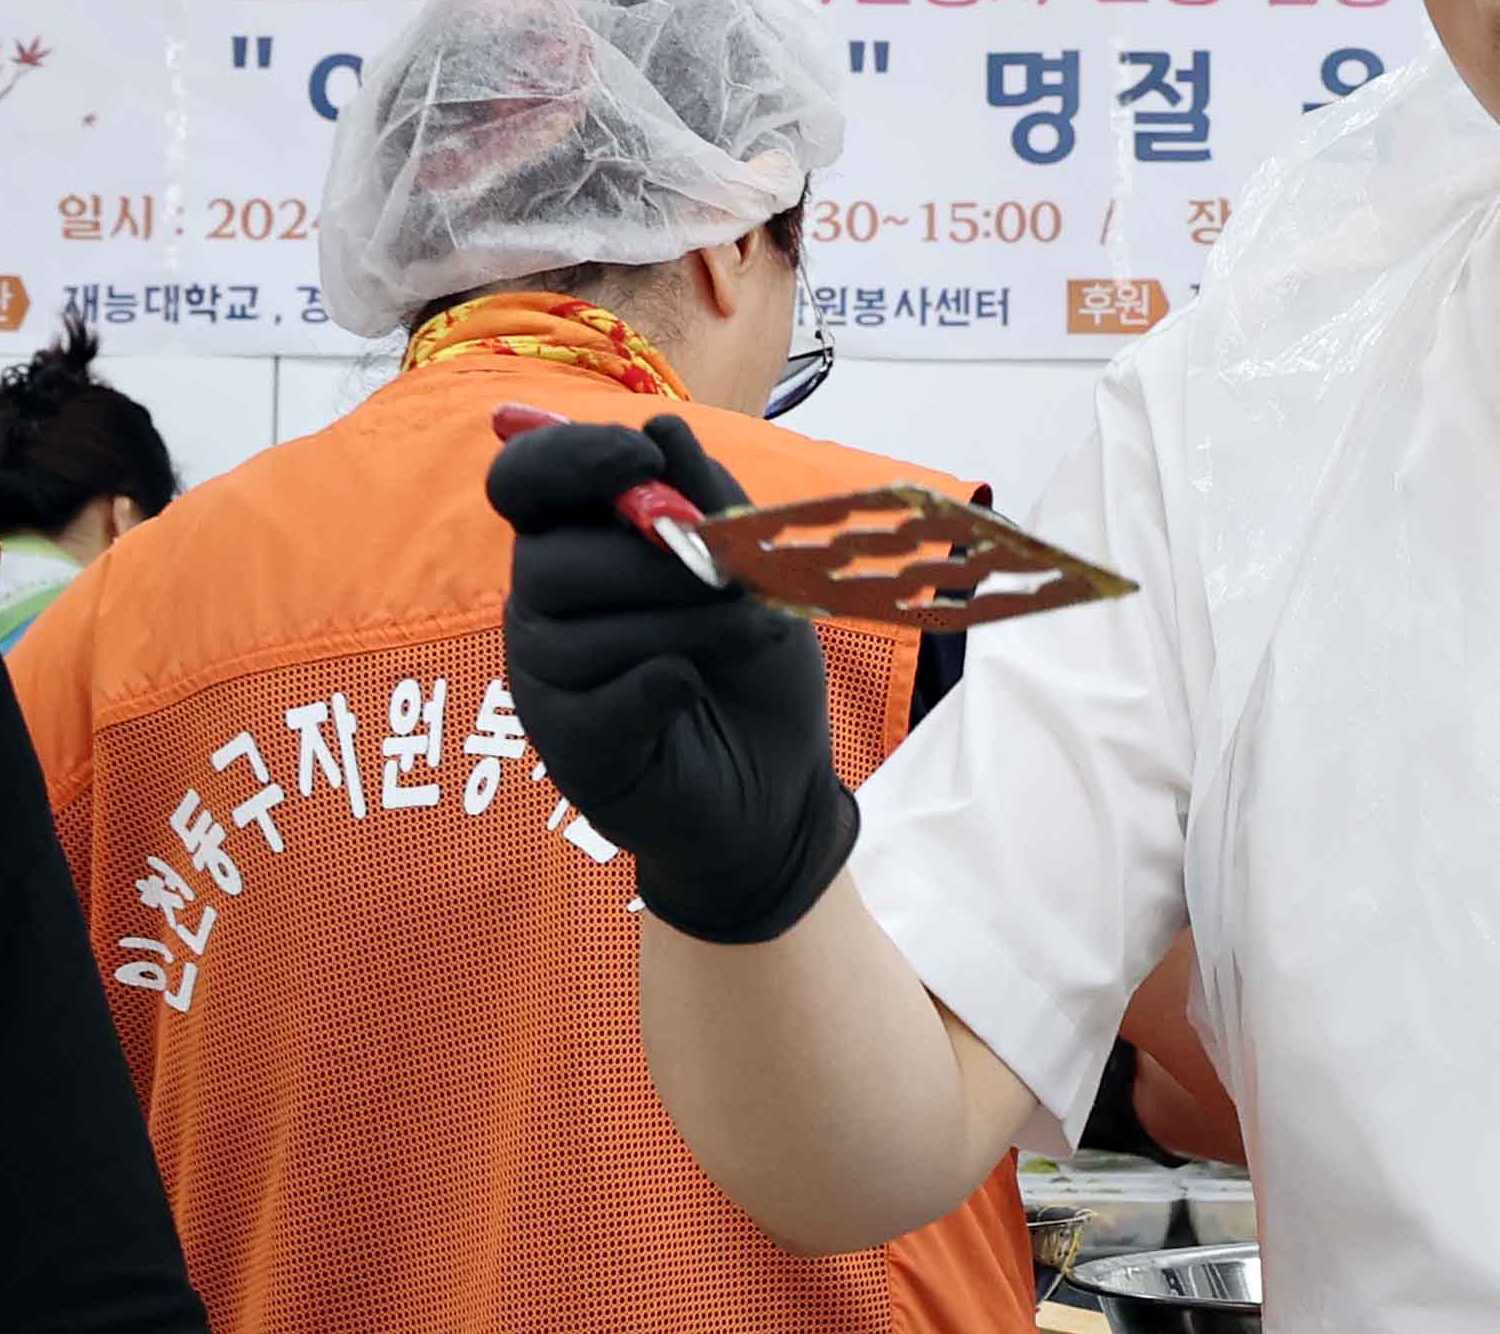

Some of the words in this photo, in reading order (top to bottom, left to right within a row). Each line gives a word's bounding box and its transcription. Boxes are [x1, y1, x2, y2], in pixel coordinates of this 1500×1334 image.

[986, 49, 1212, 166] 명절
[204, 197, 320, 242] 202
[1077, 283, 1151, 327] 후원
[114, 677, 646, 1013] 인천동구자원봉
